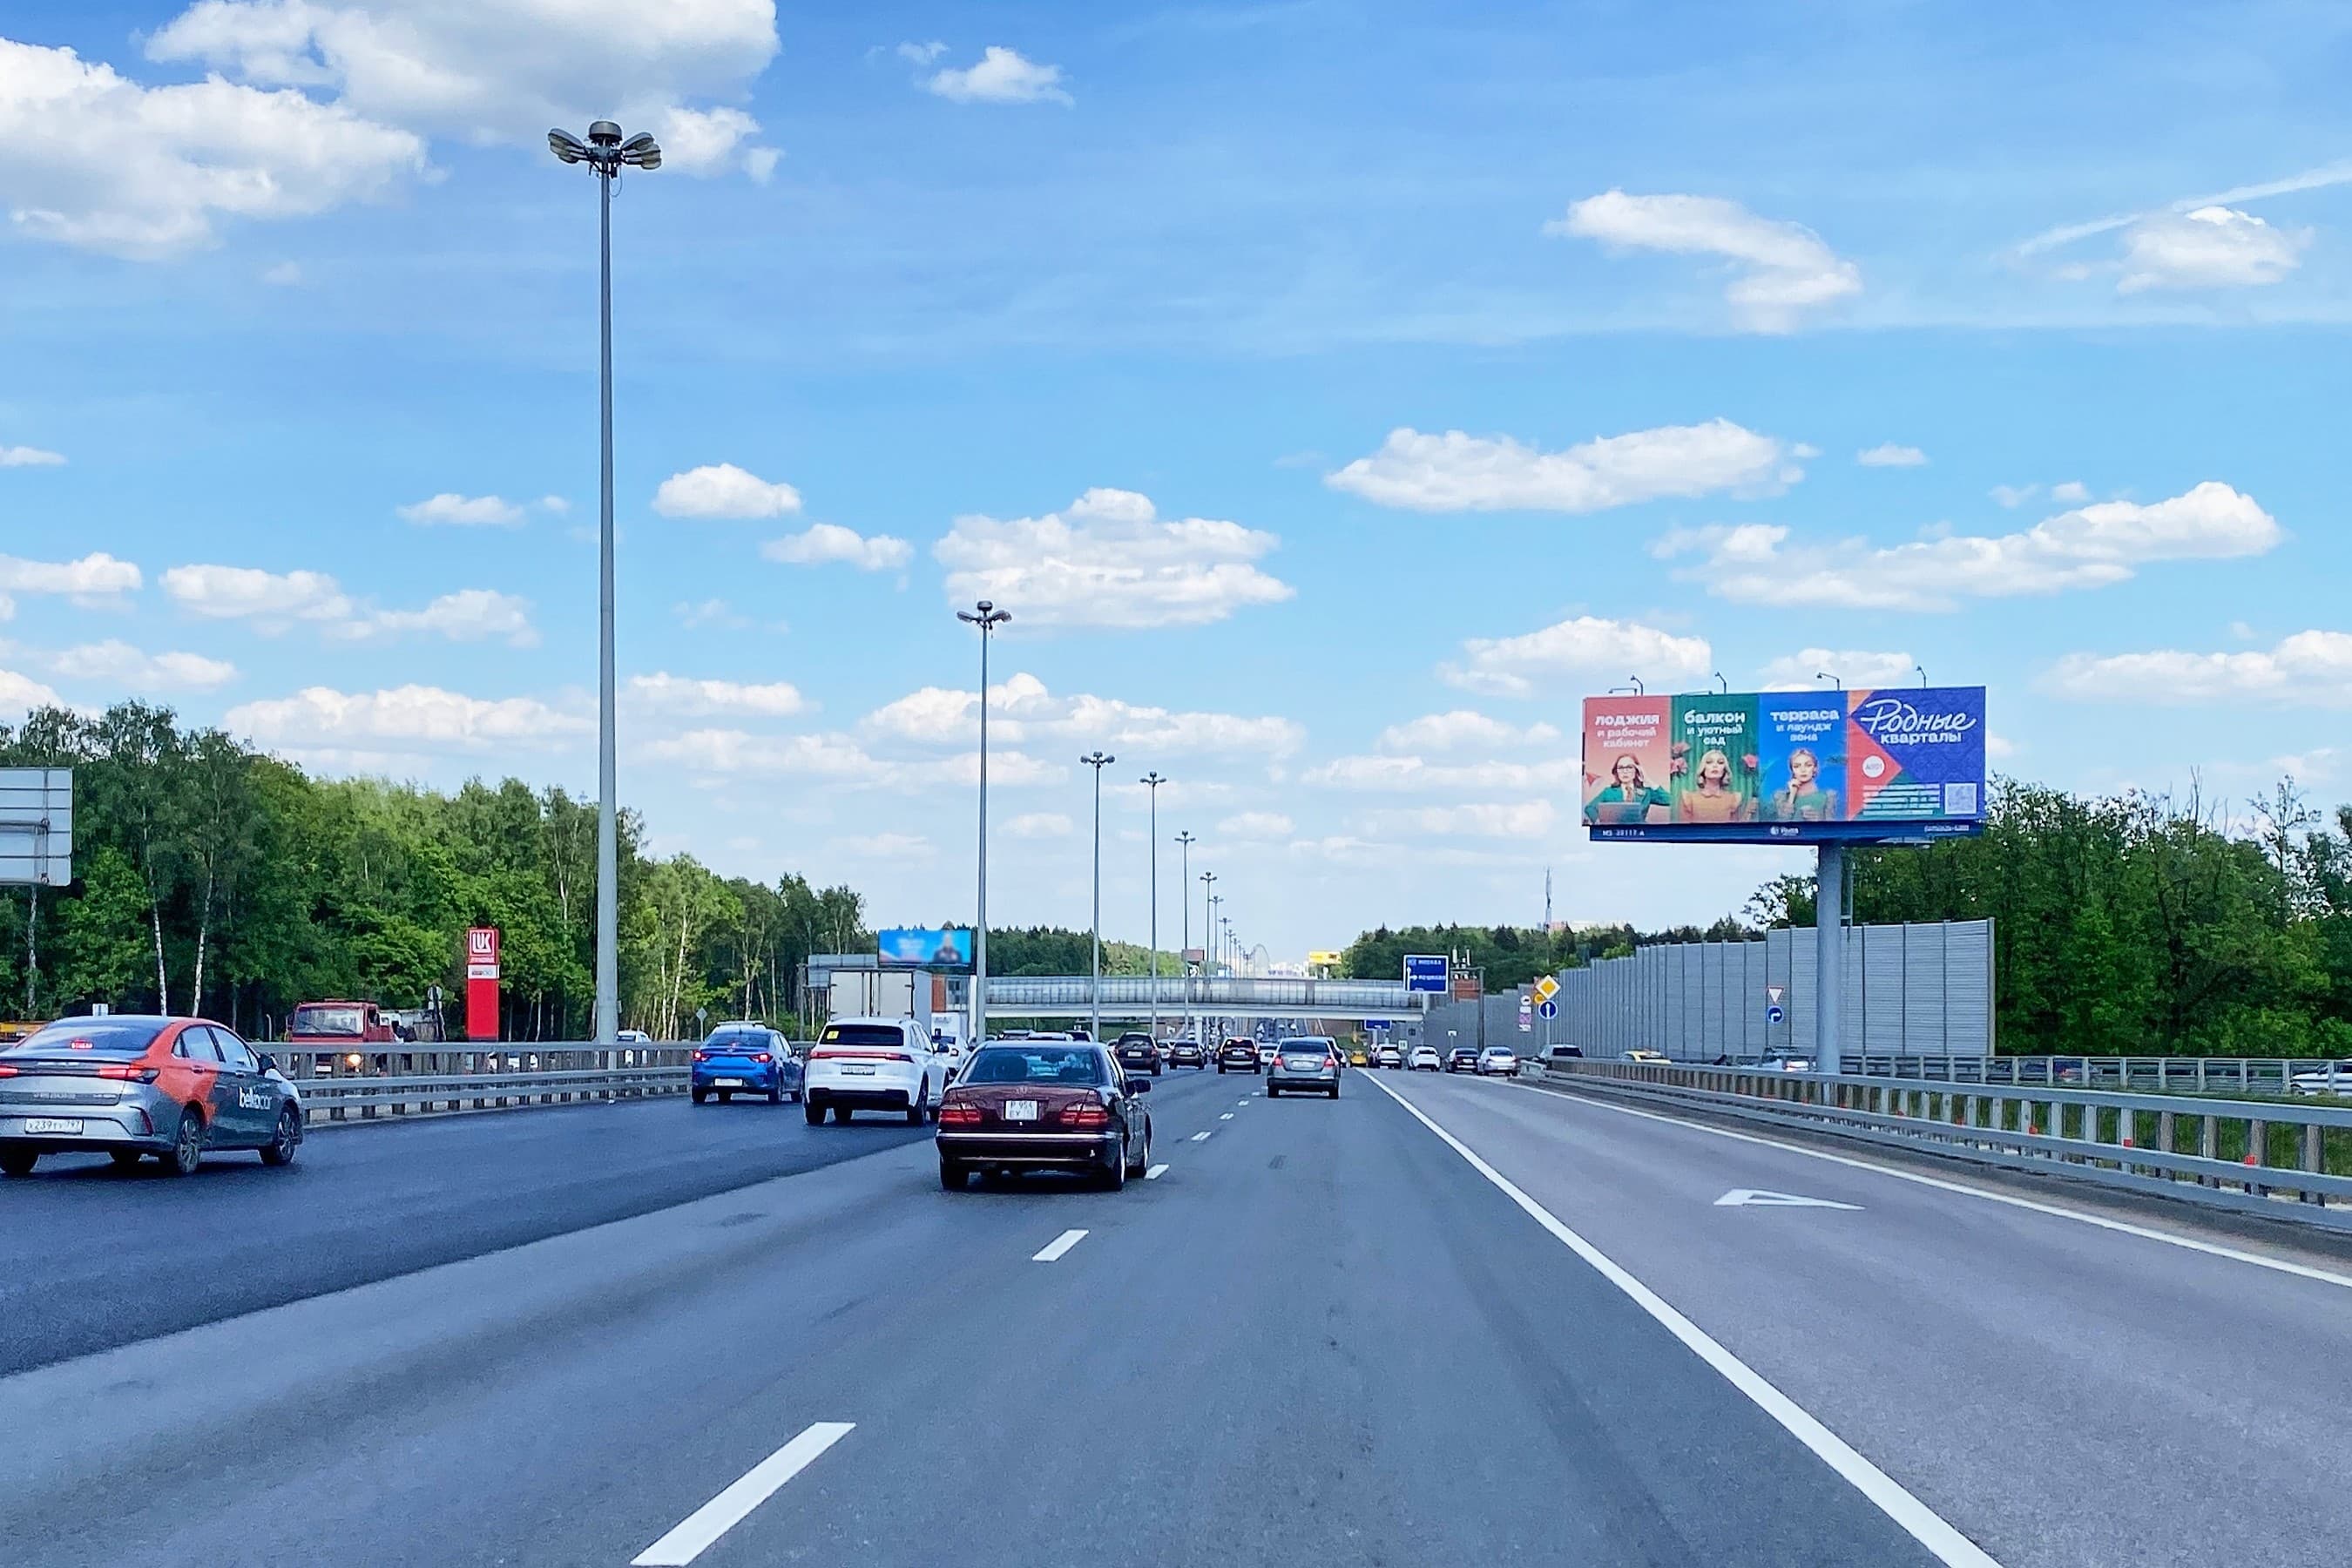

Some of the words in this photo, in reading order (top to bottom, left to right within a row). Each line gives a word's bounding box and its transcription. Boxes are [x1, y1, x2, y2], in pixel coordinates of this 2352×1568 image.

[1595, 714, 1660, 727] лоджия
[1684, 709, 1746, 724] балкон
[1769, 710, 1840, 722] терраса
[1860, 699, 1977, 734] Родные
[1686, 727, 1695, 735] и
[1697, 724, 1743, 737] уютный
[1703, 736, 1726, 747] сад
[1881, 732, 1962, 746] кварталы
